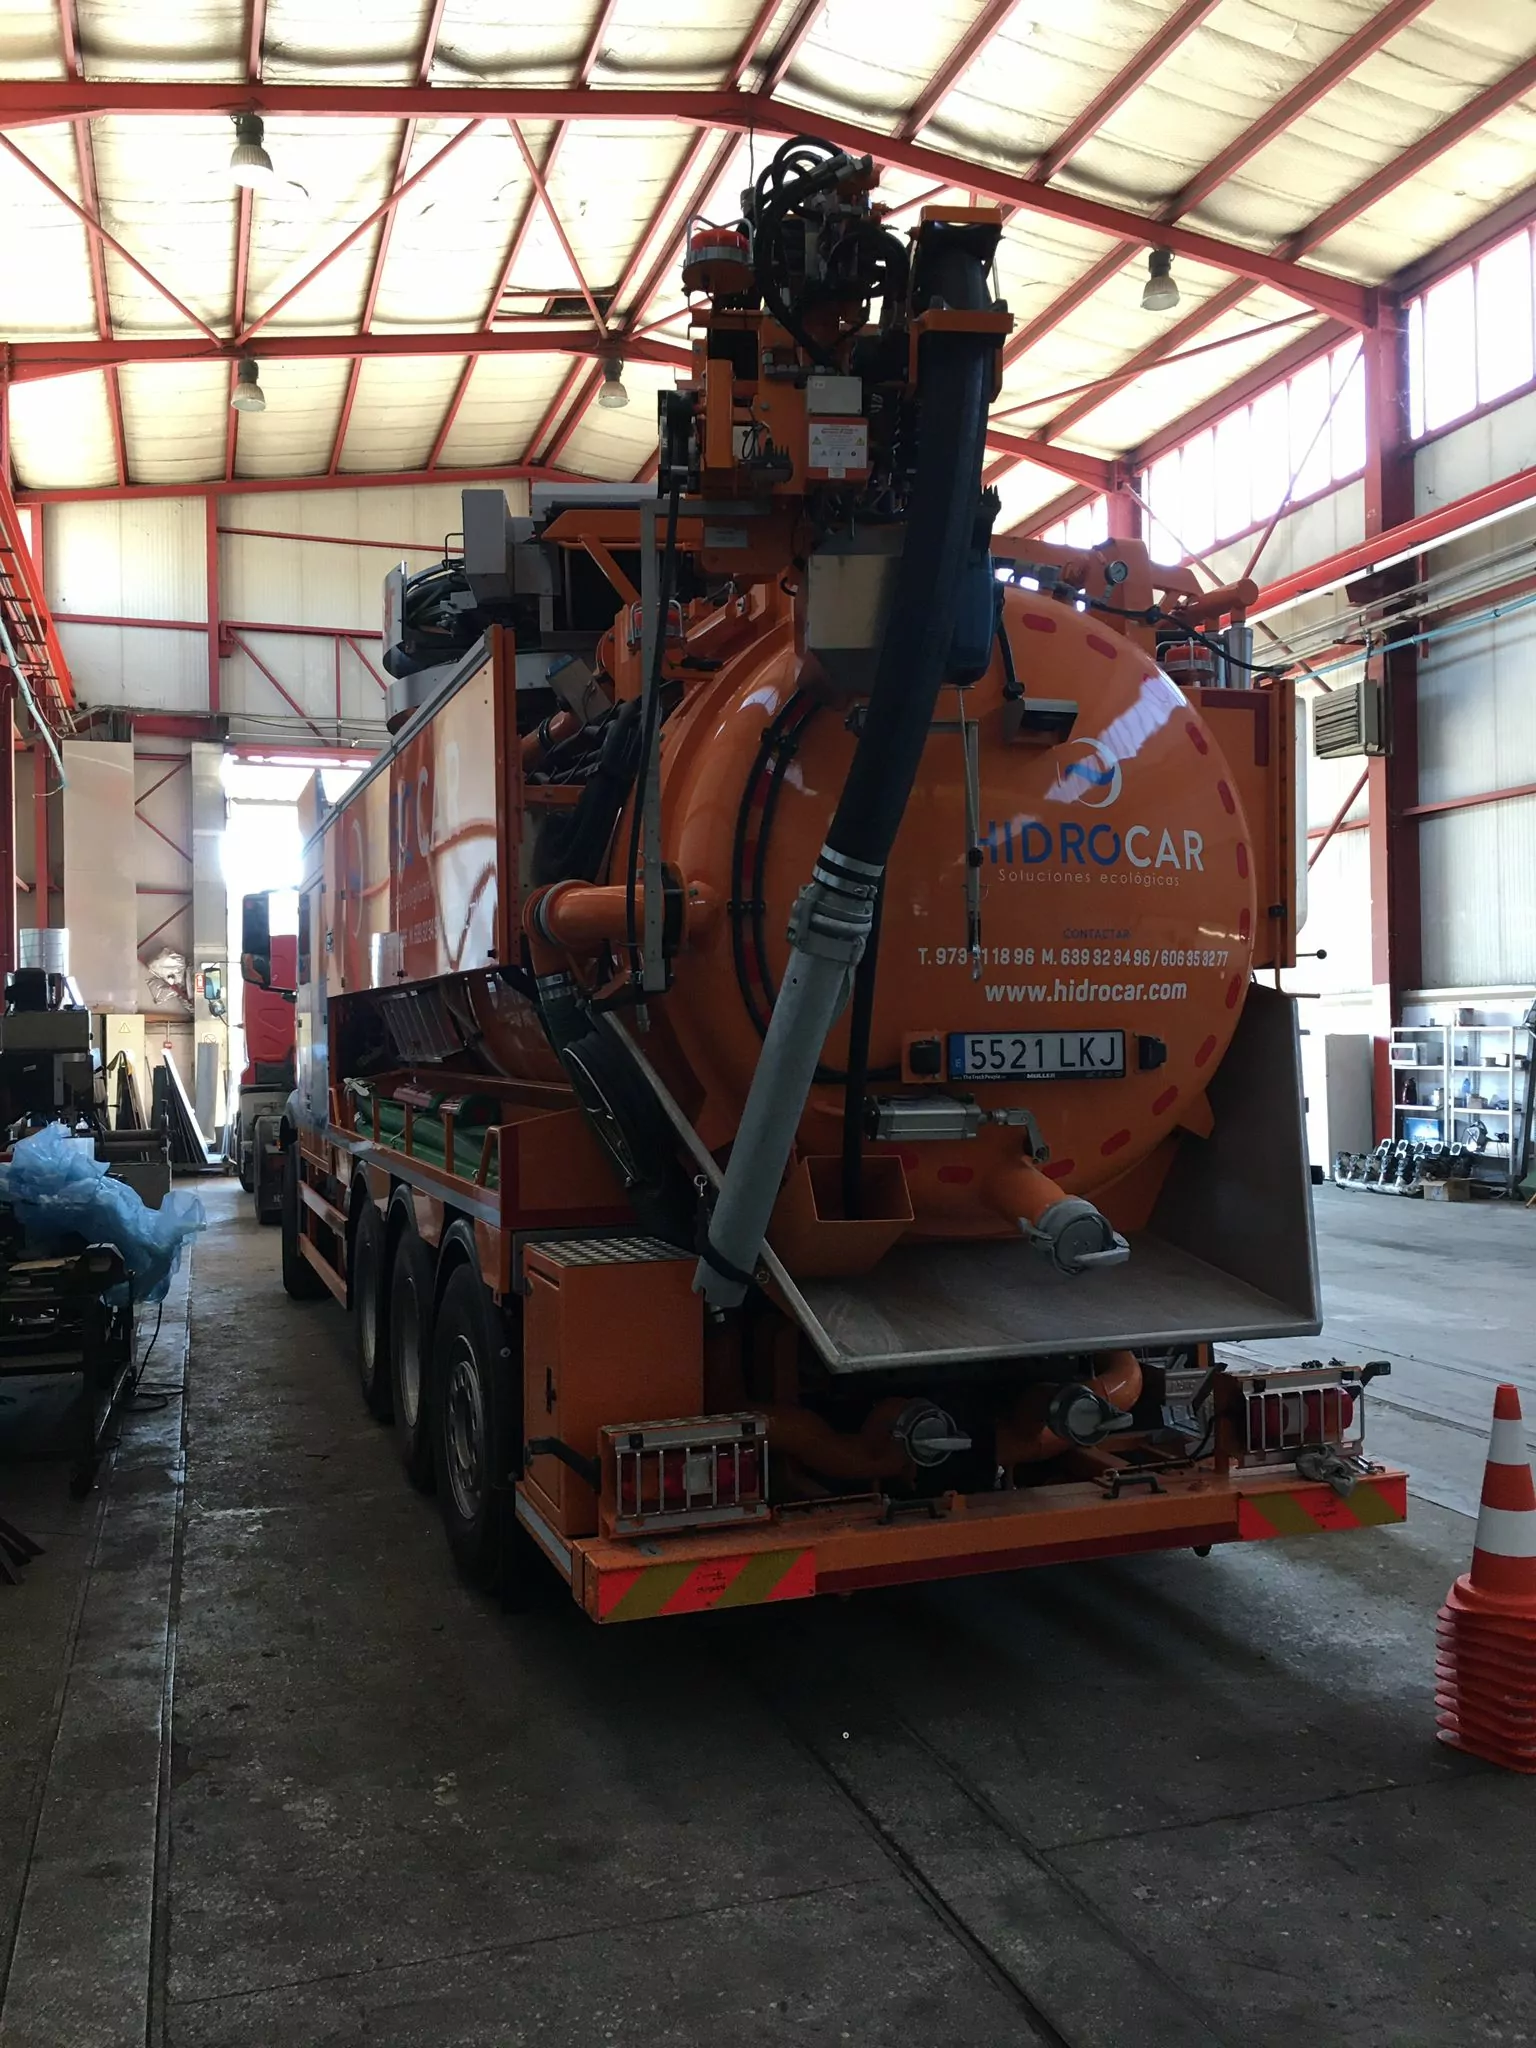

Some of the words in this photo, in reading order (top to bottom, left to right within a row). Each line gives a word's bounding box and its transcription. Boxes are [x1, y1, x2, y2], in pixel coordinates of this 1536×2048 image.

[977, 820, 1204, 871] HIDROCAR
[998, 868, 1091, 884] Soluciones
[1099, 871, 1180, 887] ecológicas
[1063, 929, 1131, 940] CONTACTAR
[918, 947, 932, 965] T.
[935, 947, 967, 965] 973
[992, 947, 1010, 965] 18
[1013, 947, 1035, 965] 96
[1041, 947, 1057, 966] M.
[1060, 947, 1090, 966] 639
[1133, 948, 1151, 966] 96
[1161, 949, 1184, 966] 606
[984, 979, 1187, 1003] www.hidrocar.com
[971, 1038, 1043, 1070] 5521
[1060, 1037, 1115, 1068] LKJ
